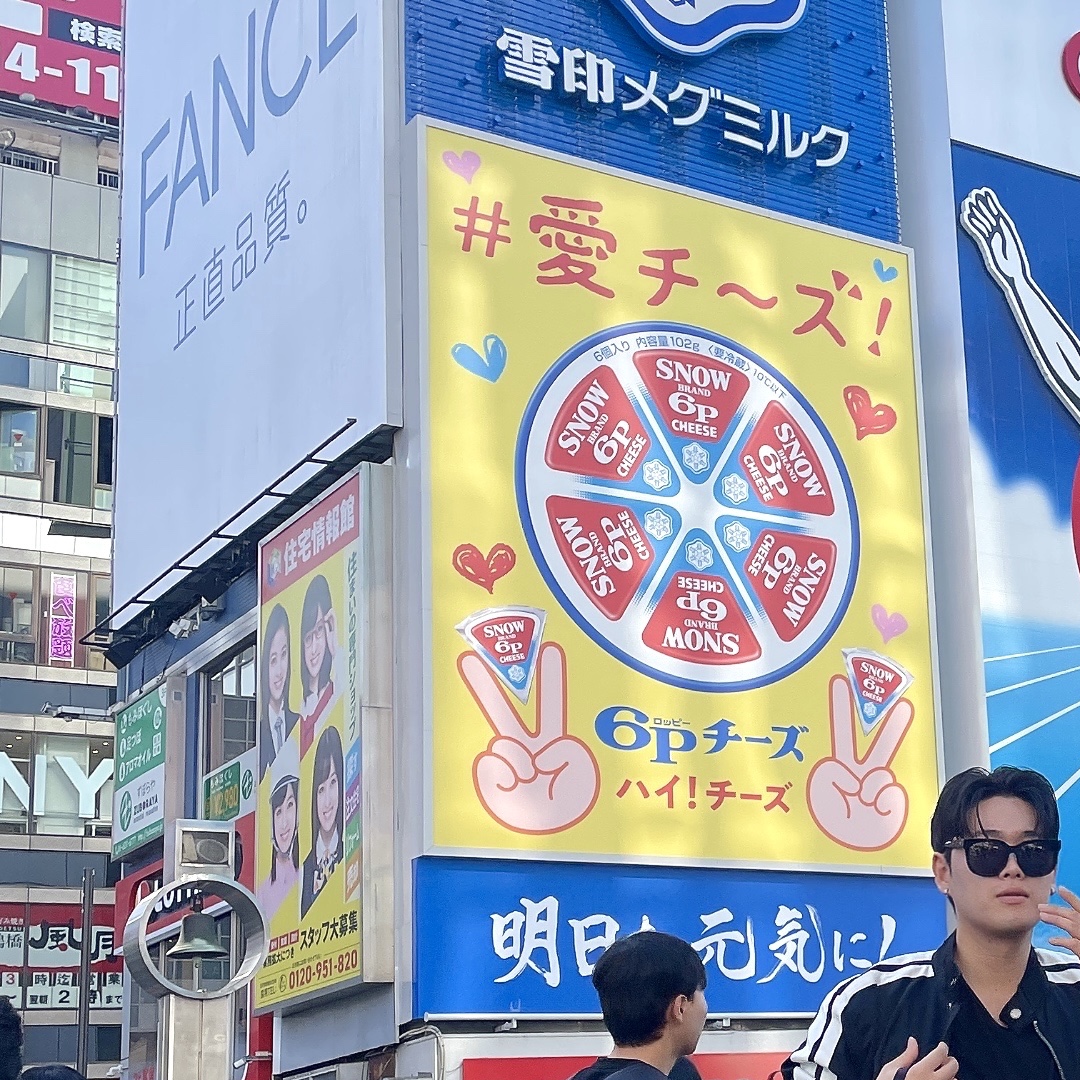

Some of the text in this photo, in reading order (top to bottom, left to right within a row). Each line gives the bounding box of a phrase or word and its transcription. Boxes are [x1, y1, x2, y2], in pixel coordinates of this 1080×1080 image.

[70, 19, 122, 51] 検索
[496, 27, 850, 167] 雪印メグミルク
[173, 170, 307, 351] 正直品質。
[656, 358, 731, 391] SNOW
[677, 383, 711, 398] BRAND
[558, 379, 610, 457] SNOW
[586, 413, 609, 445] BRAND
[671, 419, 717, 438] CHEESE
[616, 433, 647, 477] CHEESE
[773, 423, 826, 497] SNOW
[777, 449, 799, 483] BRAND
[743, 454, 774, 502] CHEESE
[283, 494, 355, 576] 住宅情報館
[588, 531, 612, 568] BRAND
[617, 510, 650, 560] CHEESE
[556, 517, 616, 597] SNOW
[747, 534, 775, 577] CHEESE
[677, 576, 724, 594] CHEESE
[782, 564, 802, 595] BRAND
[782, 552, 827, 628] SNOW
[483, 620, 525, 638] SNOW
[661, 626, 740, 655] SNOW
[684, 619, 718, 631] BRAND
[499, 653, 526, 664] CHEESE
[860, 661, 895, 683] SNOW
[862, 690, 883, 703] CHEESE
[300, 909, 358, 950] スタッフ大募集
[490, 895, 897, 987] 明日元気に!
[289, 949, 358, 979] 0120-951-820
